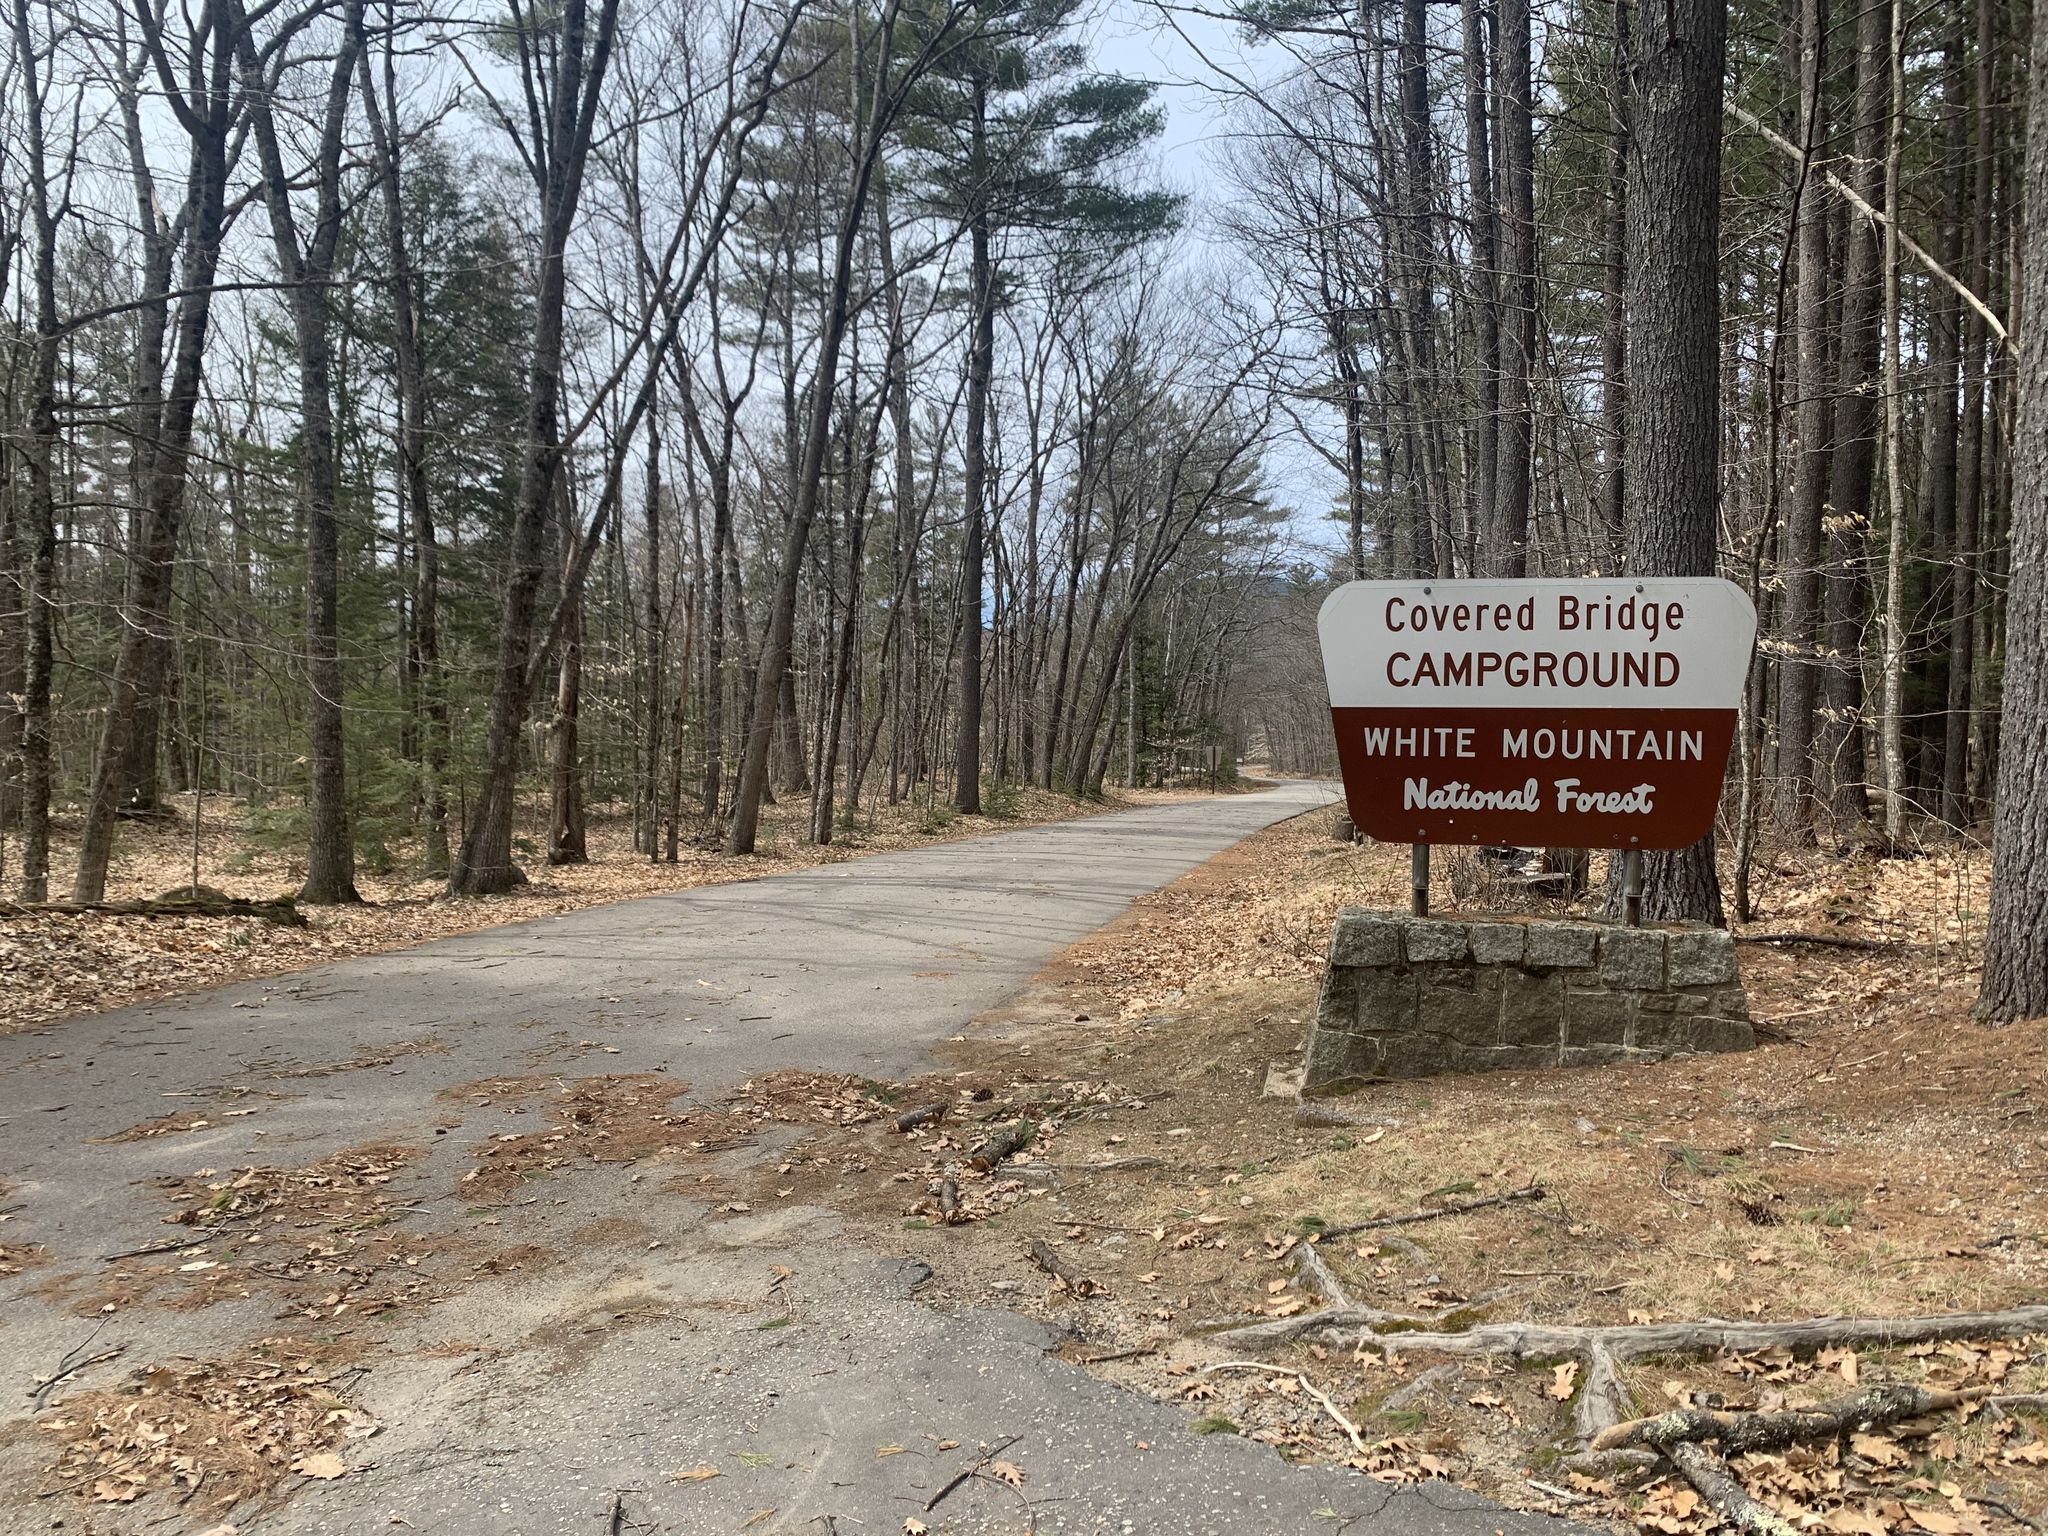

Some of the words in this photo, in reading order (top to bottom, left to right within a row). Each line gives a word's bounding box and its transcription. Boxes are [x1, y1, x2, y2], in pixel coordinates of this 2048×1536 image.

[1385, 595, 1535, 633] Covered
[1558, 594, 1685, 643] Bridge
[1386, 650, 1681, 688] CAMPGROUND
[1364, 727, 1476, 758] WHITE
[1502, 728, 1703, 761] MOUNTAIN
[1403, 777, 1541, 813] National
[1553, 778, 1656, 814] Forest
